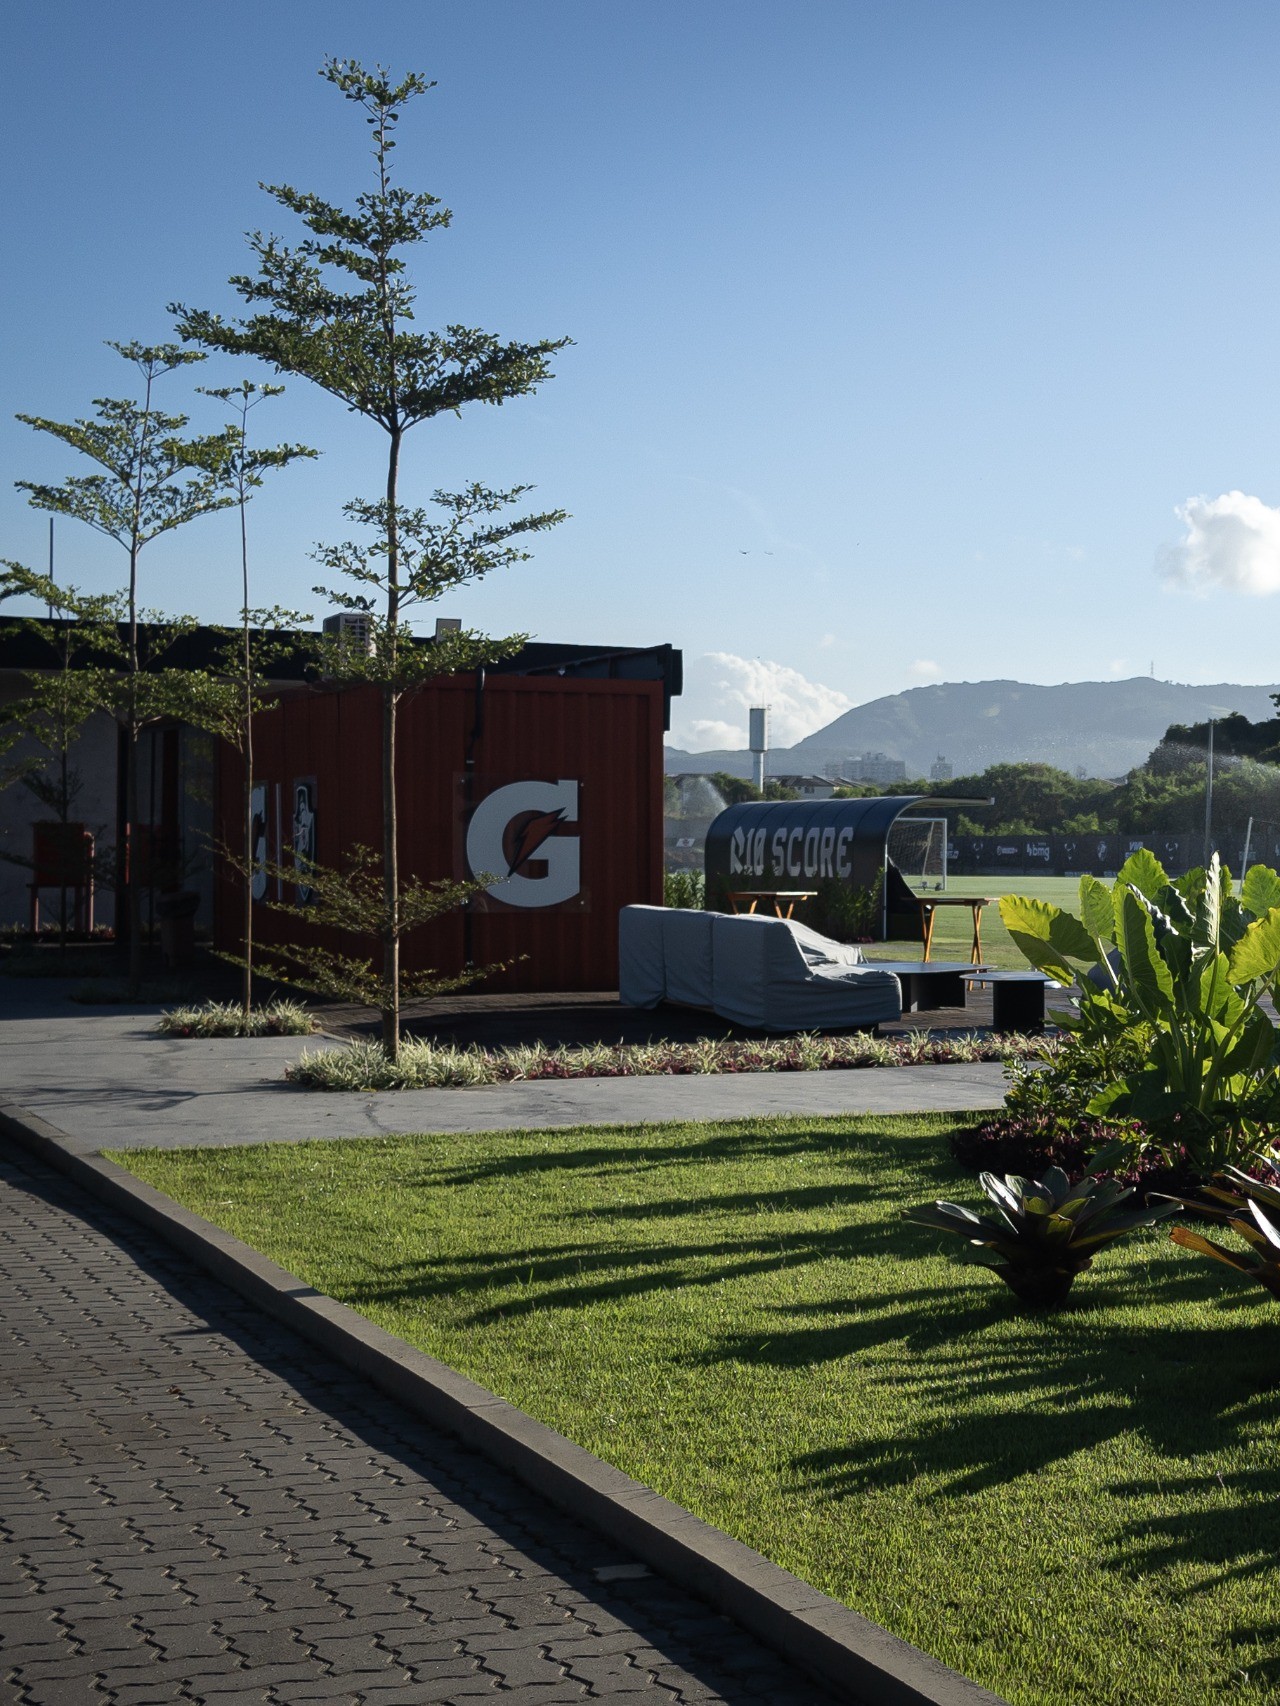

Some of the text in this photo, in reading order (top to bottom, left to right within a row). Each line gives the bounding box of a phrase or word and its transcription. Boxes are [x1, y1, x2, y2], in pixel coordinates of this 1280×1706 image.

[466, 780, 580, 907] G
[772, 826, 854, 878] SCORE
[1033, 843, 1050, 862] bmg
